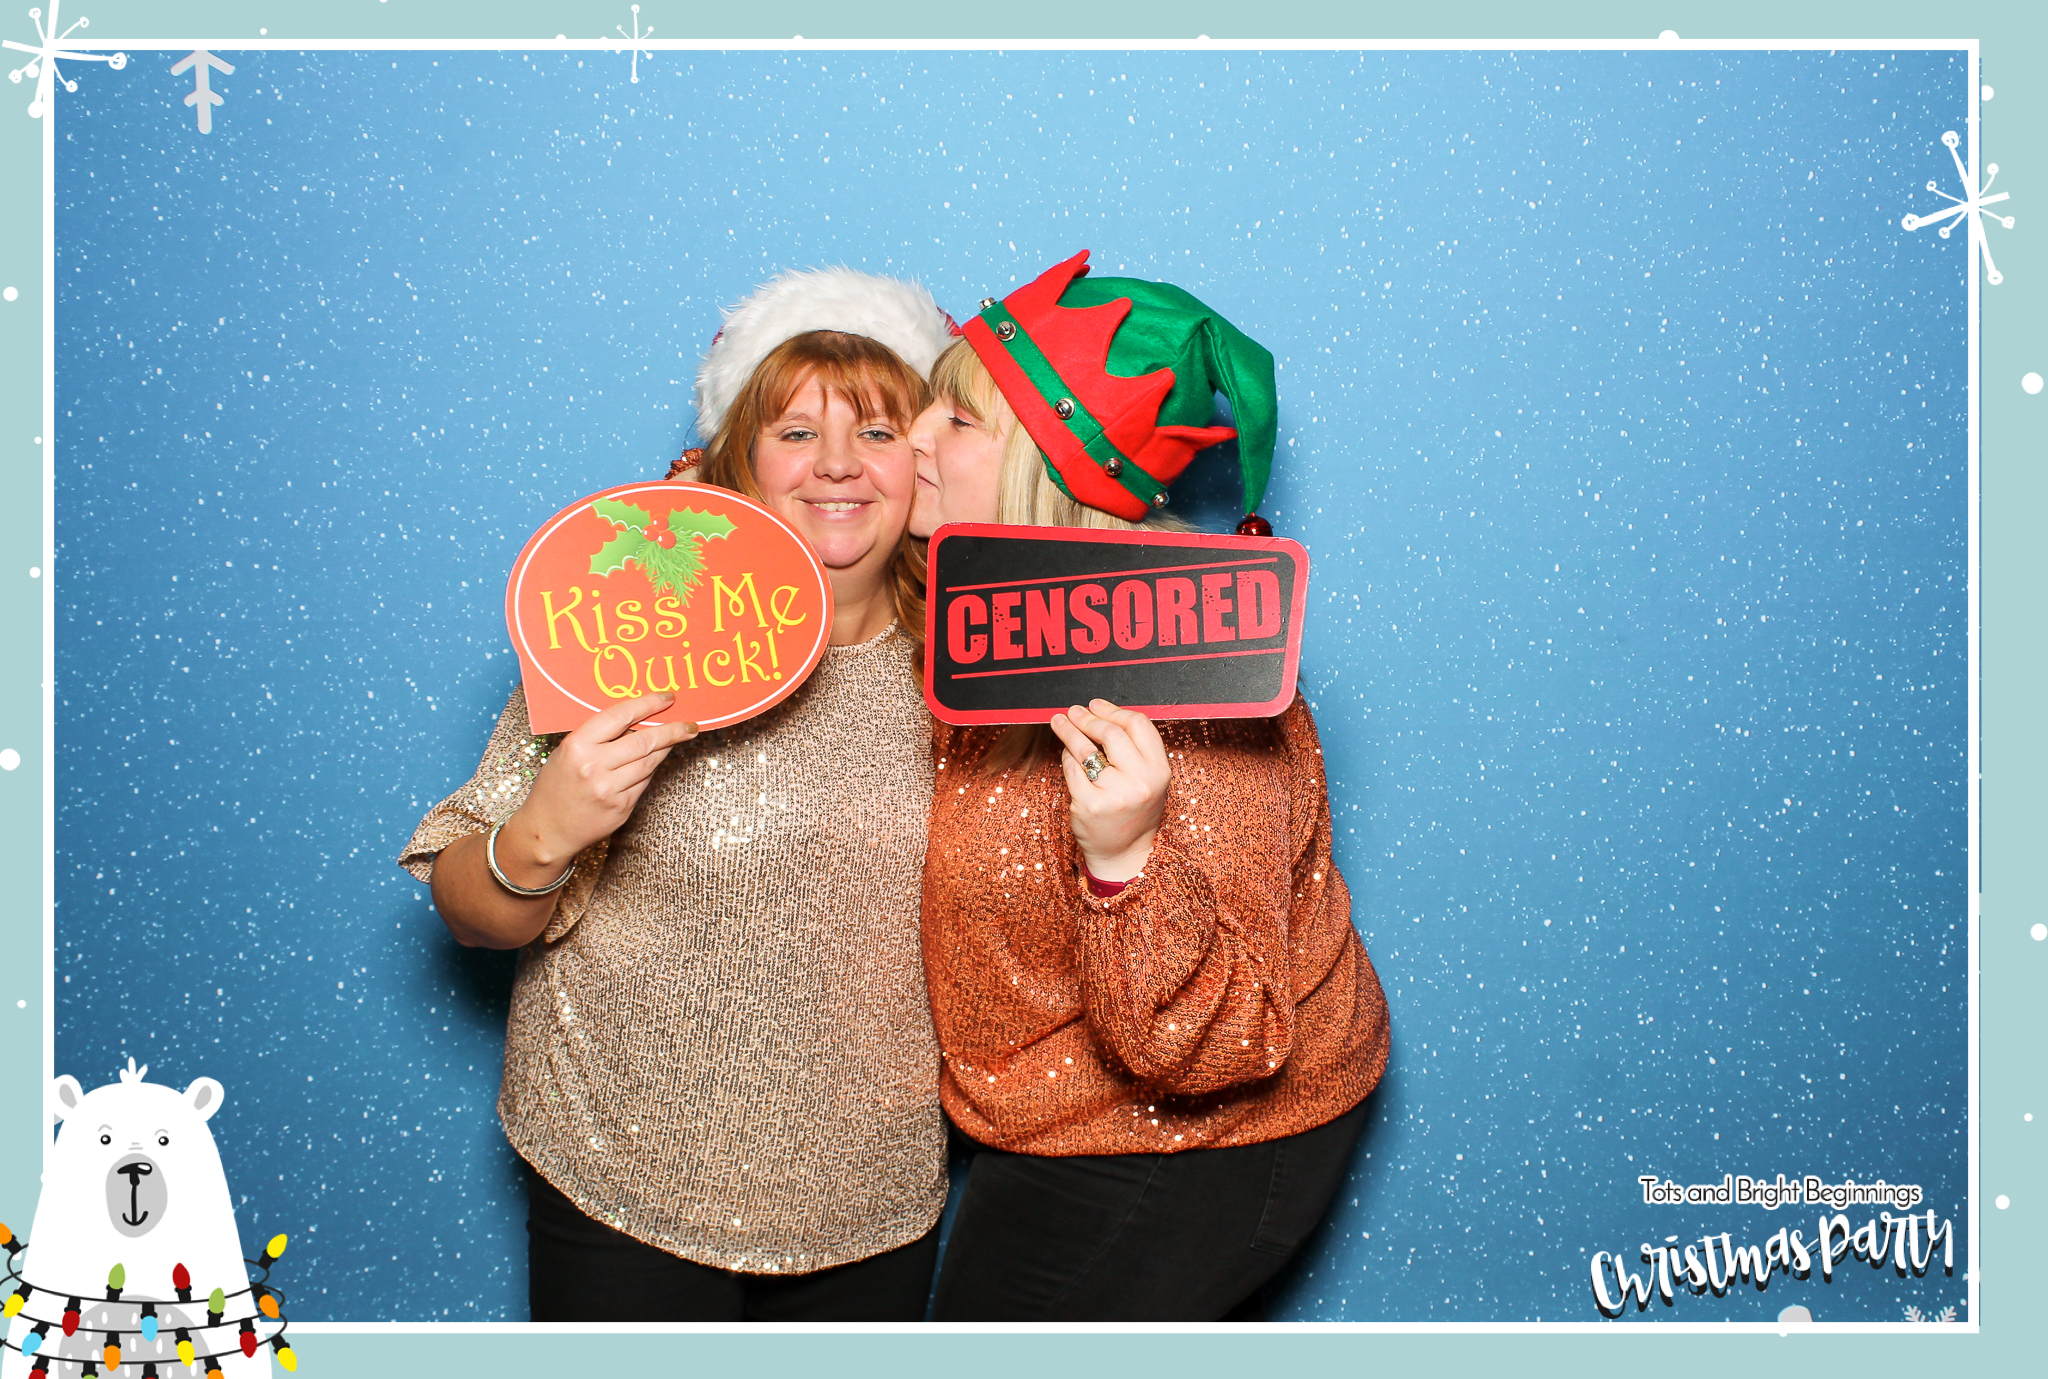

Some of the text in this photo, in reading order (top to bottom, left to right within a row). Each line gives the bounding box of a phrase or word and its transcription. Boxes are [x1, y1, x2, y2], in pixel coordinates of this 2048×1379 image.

[539, 572, 807, 653] Kiss Me
[946, 569, 1282, 665] CENSORED
[593, 628, 783, 699] Quick!
